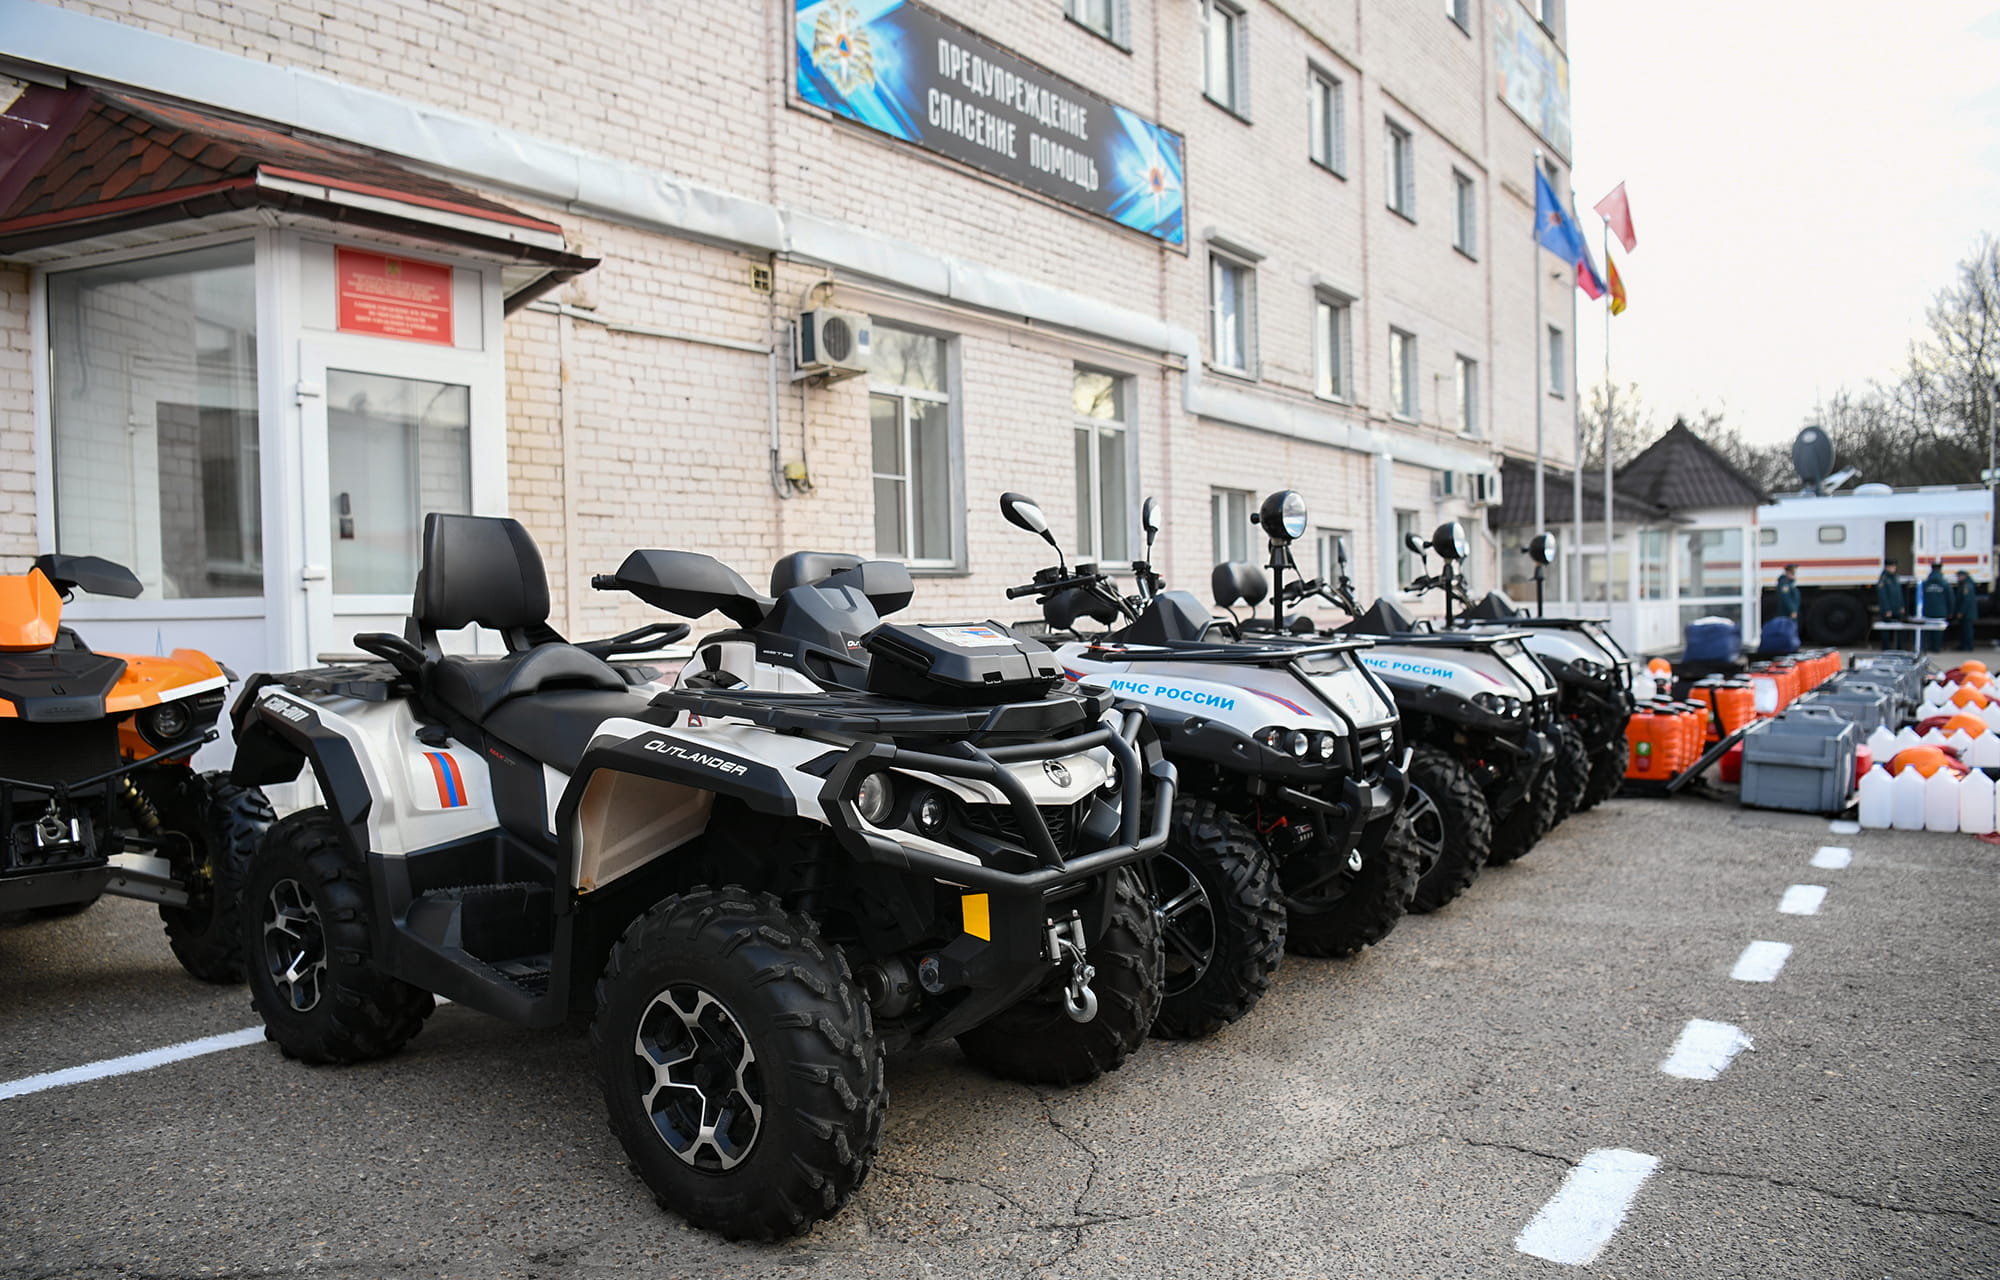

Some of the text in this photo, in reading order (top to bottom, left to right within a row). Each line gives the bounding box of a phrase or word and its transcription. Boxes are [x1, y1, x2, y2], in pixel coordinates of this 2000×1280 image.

[938, 38, 1088, 141] ПРЕДУПРЕЖДЕНИЕ
[928, 88, 1099, 192] СПАСЕНИЕ ПОМОЩЬ
[1110, 679, 1235, 711] МЧС РОССИИ
[1392, 661, 1454, 679] РОССИИ
